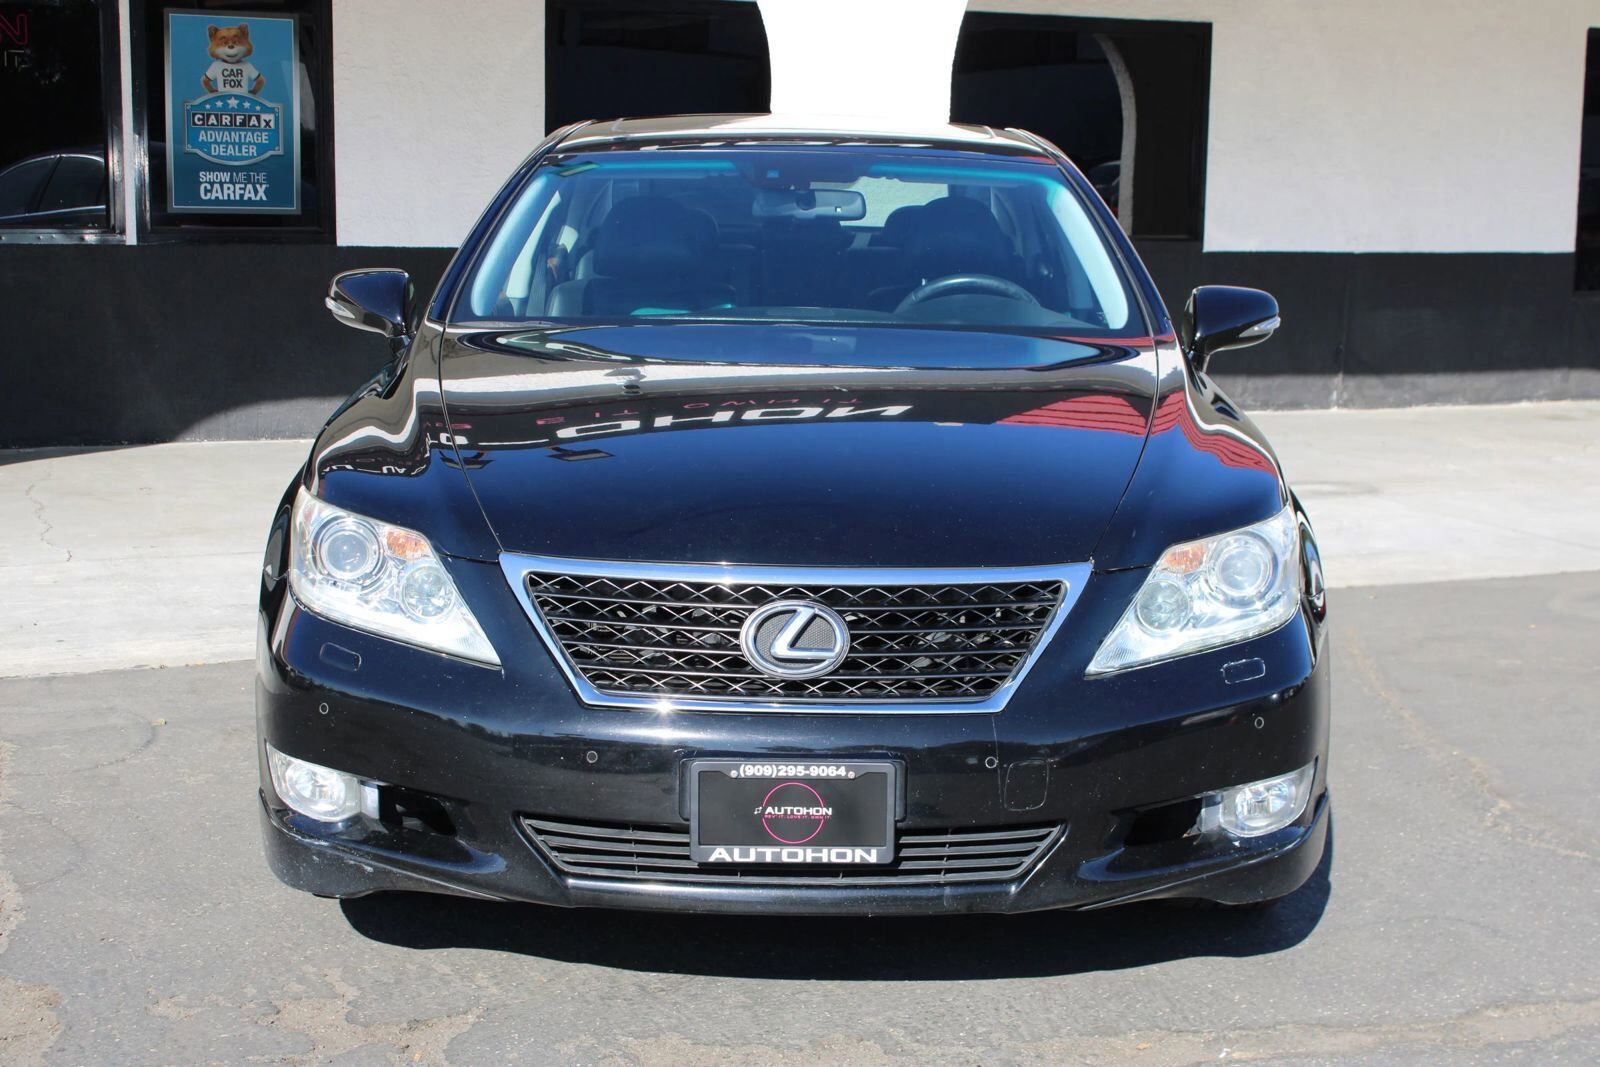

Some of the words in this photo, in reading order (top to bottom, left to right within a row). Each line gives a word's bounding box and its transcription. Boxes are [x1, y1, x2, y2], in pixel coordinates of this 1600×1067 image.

[222, 68, 243, 78] CAR
[223, 79, 243, 89] FOX
[194, 114, 273, 129] CARFAX
[199, 130, 269, 143] ADVANTAGE
[211, 144, 257, 157] DEALER
[199, 171, 230, 182] SHOW
[233, 172, 247, 183] ME
[249, 172, 267, 183] THE
[200, 183, 268, 201] CARFAX
[739, 764, 847, 778] (909)295-9064
[765, 806, 833, 816] AUTOHON
[708, 847, 878, 863] AUTOHON
